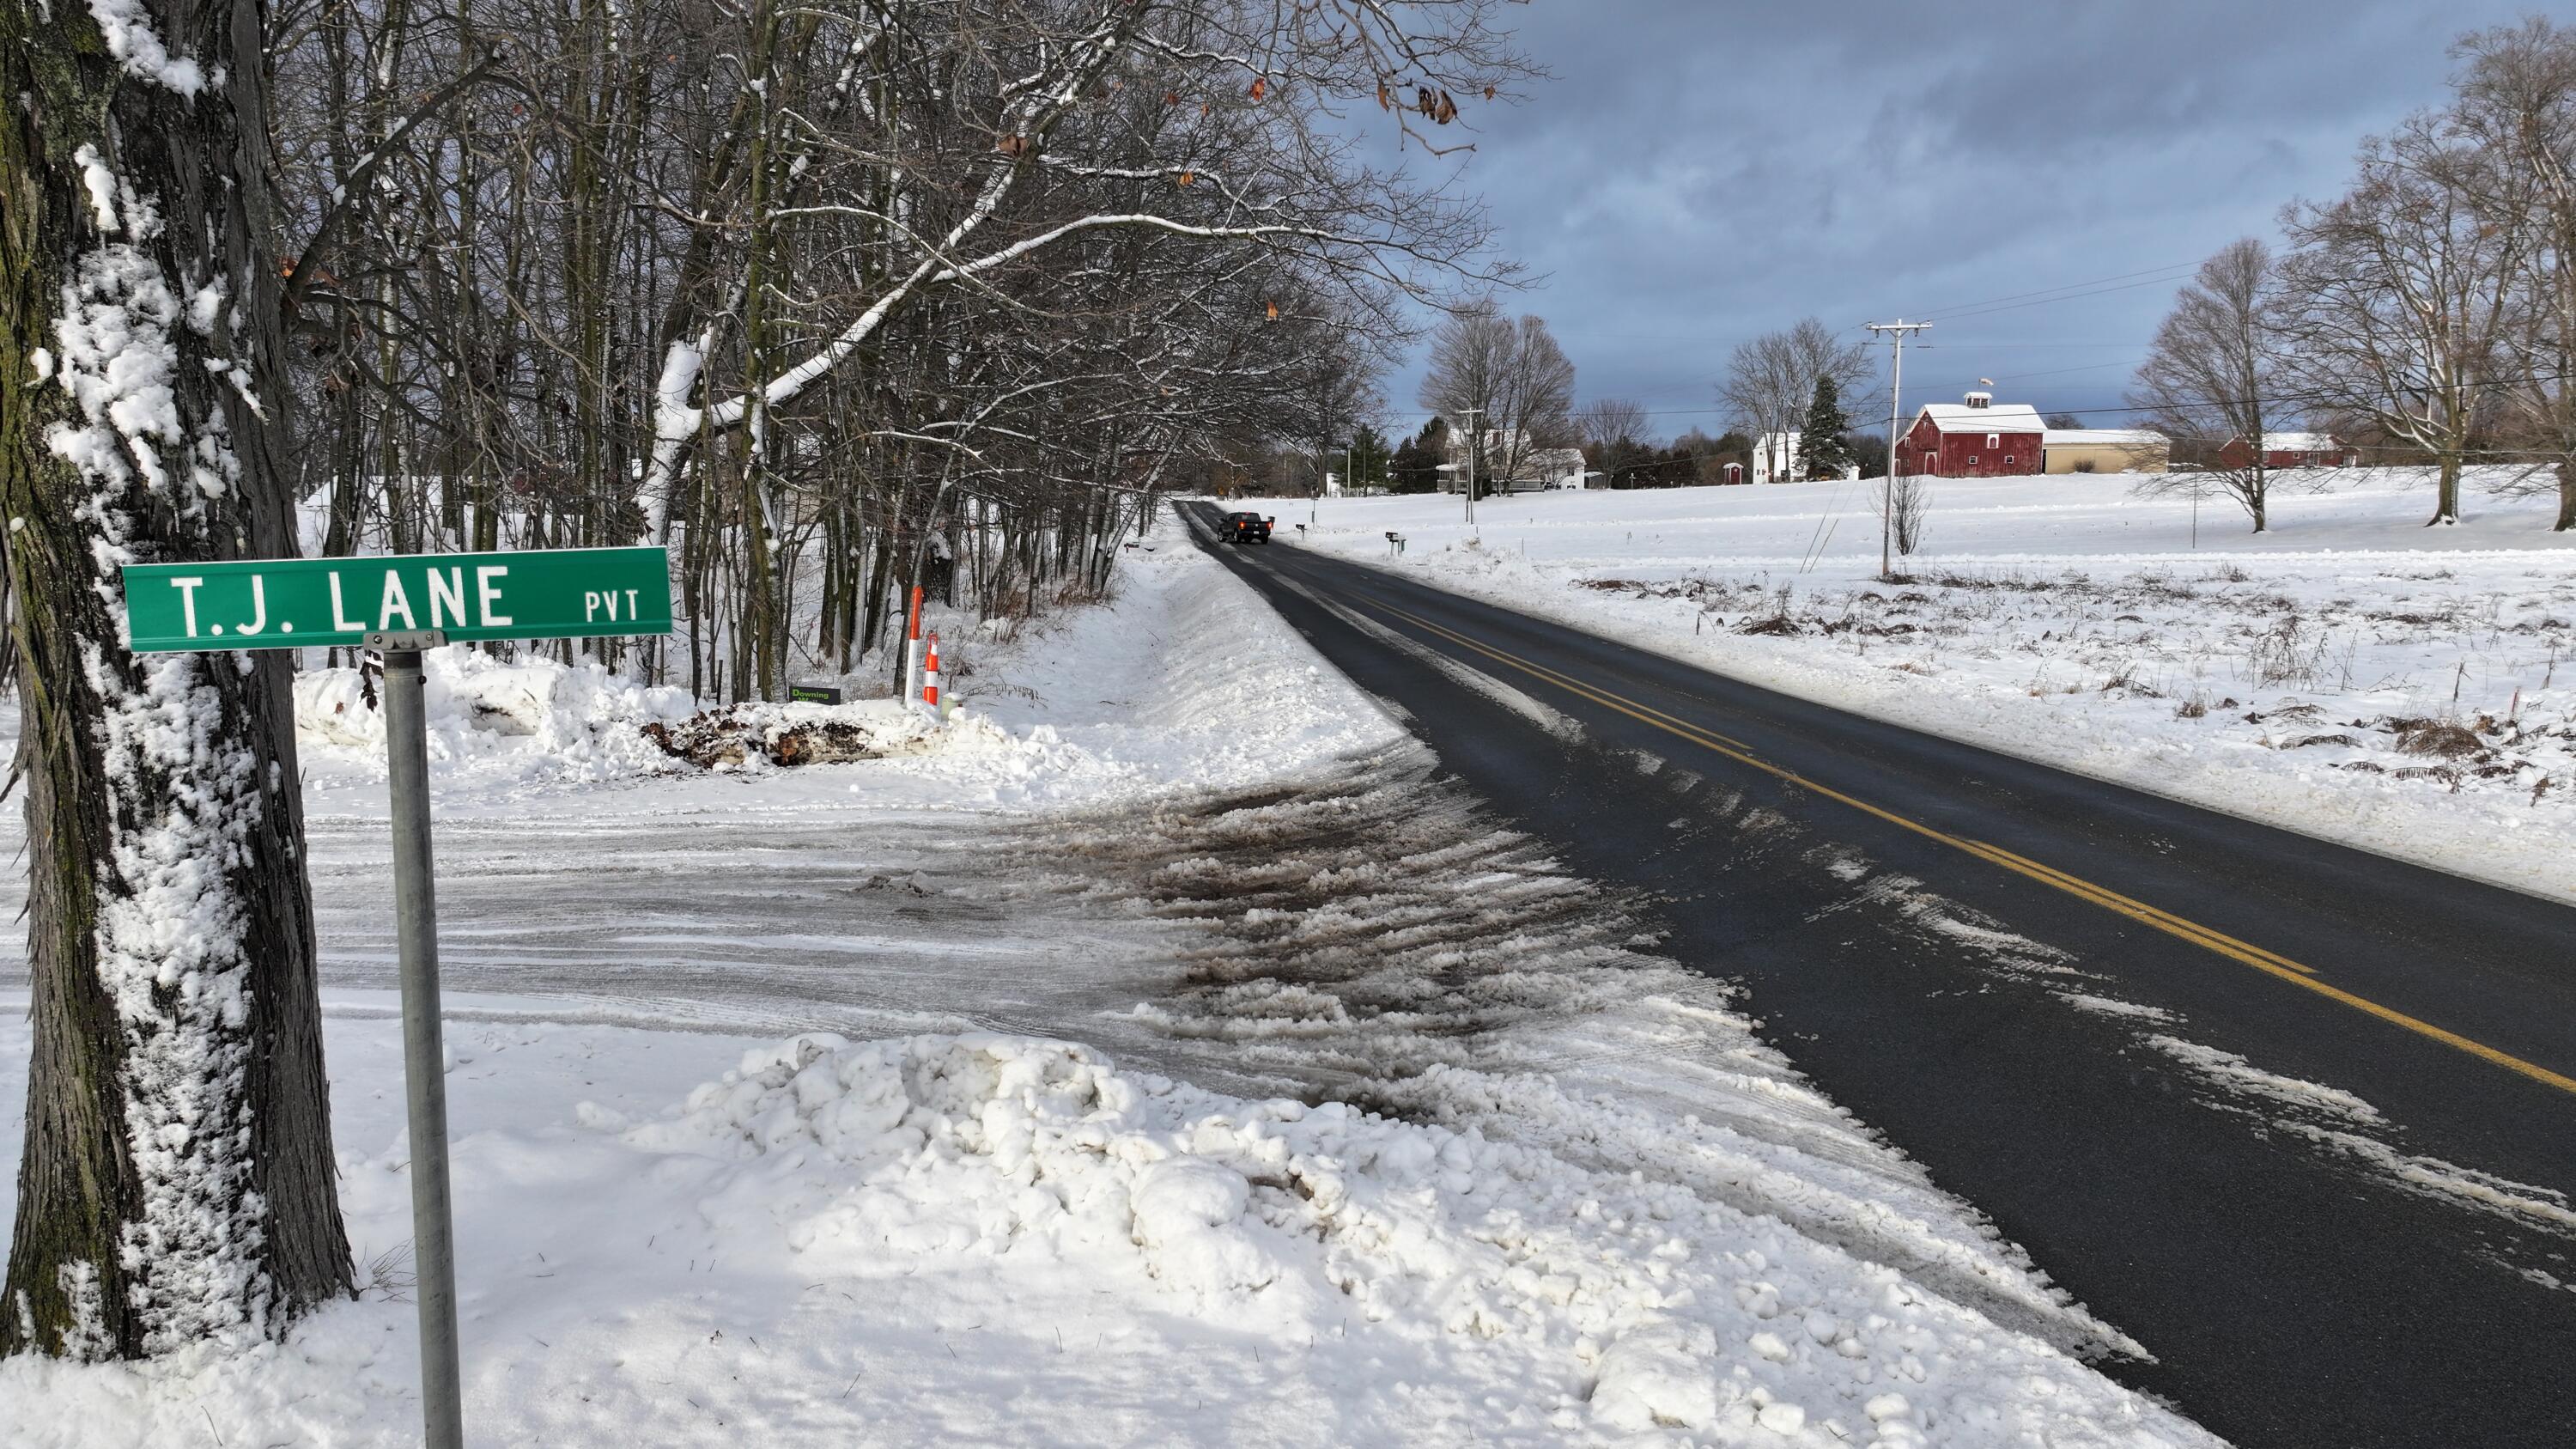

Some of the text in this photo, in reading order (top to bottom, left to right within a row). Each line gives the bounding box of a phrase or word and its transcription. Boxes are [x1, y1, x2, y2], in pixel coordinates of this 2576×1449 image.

[170, 565, 638, 638] T.J. LANE PVT
[792, 689, 829, 700] Downing
